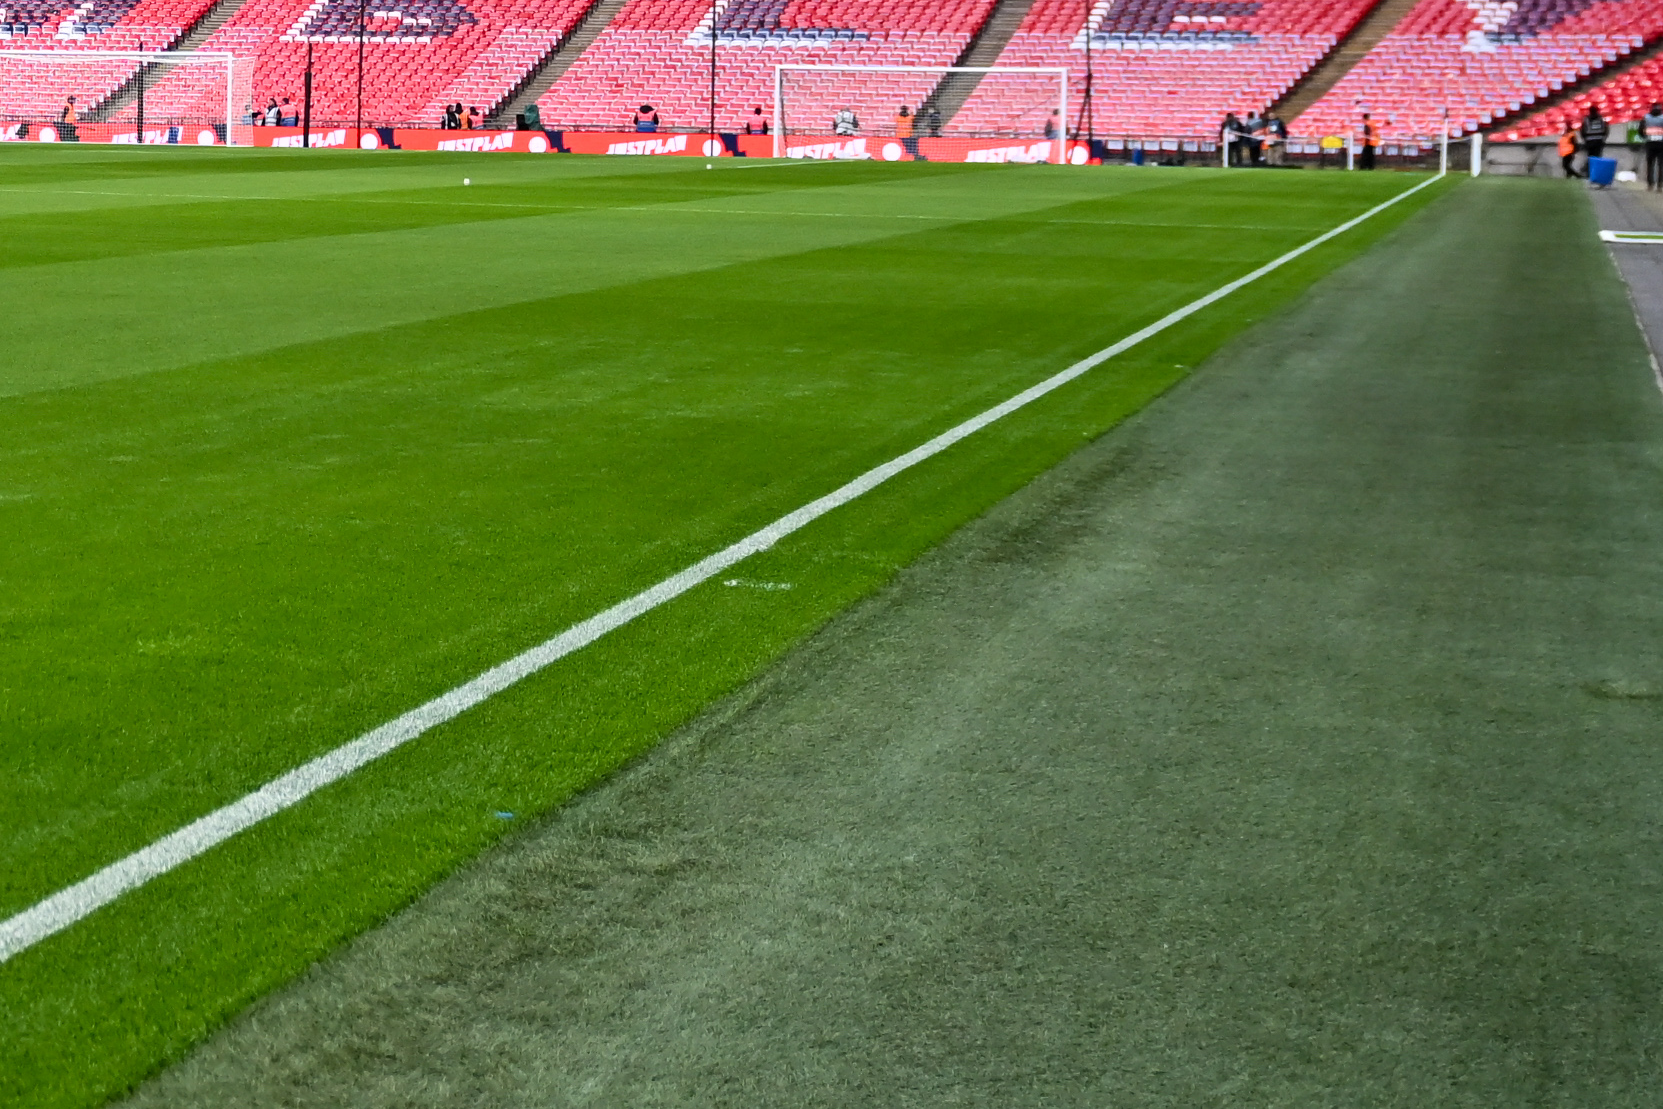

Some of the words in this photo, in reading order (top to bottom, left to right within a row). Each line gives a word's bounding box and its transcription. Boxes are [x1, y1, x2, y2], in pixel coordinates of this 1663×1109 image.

[272, 130, 347, 148] JUSPLAY
[438, 132, 514, 152] JUSTPLAY
[606, 135, 687, 155] JUSTPLAY
[786, 138, 867, 159] JUSTPLAY
[964, 142, 1051, 162] JUSTPLAY
